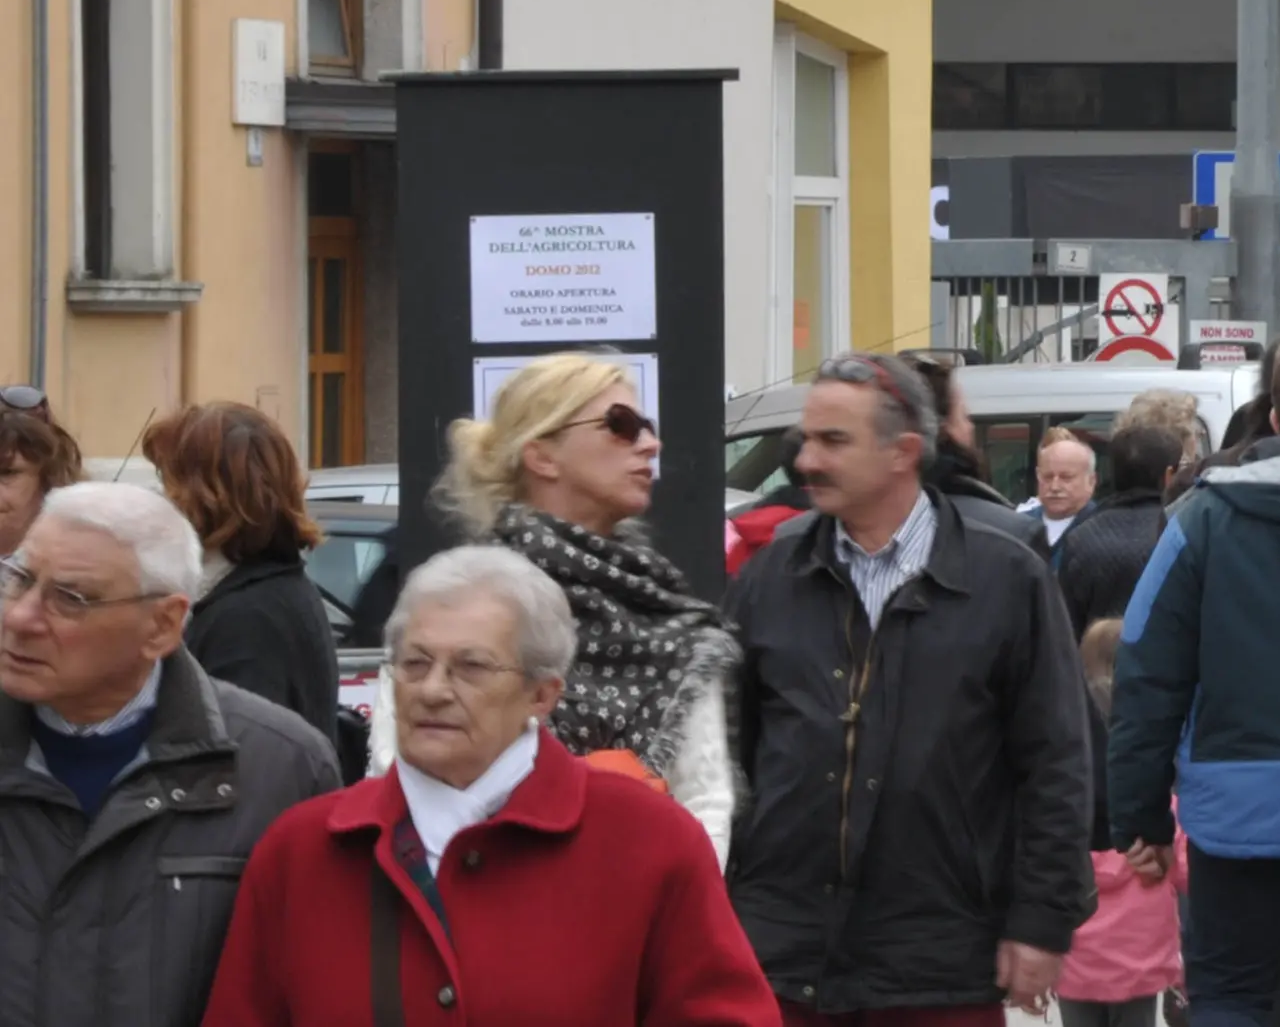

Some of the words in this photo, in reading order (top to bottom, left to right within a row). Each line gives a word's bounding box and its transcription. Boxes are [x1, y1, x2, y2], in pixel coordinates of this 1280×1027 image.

[545, 225, 605, 237] MOSTRA
[489, 239, 635, 254] DELL'AGRICOLTURA
[525, 265, 571, 276] DOMO
[575, 264, 601, 275] 2012
[510, 289, 554, 298] ORARIO
[557, 287, 617, 297] APERTURA
[504, 305, 547, 315] SABATO
[550, 306, 557, 314] E
[560, 304, 624, 314] DOMENICA
[1200, 327, 1222, 338] NON
[1225, 327, 1254, 339] SONO
